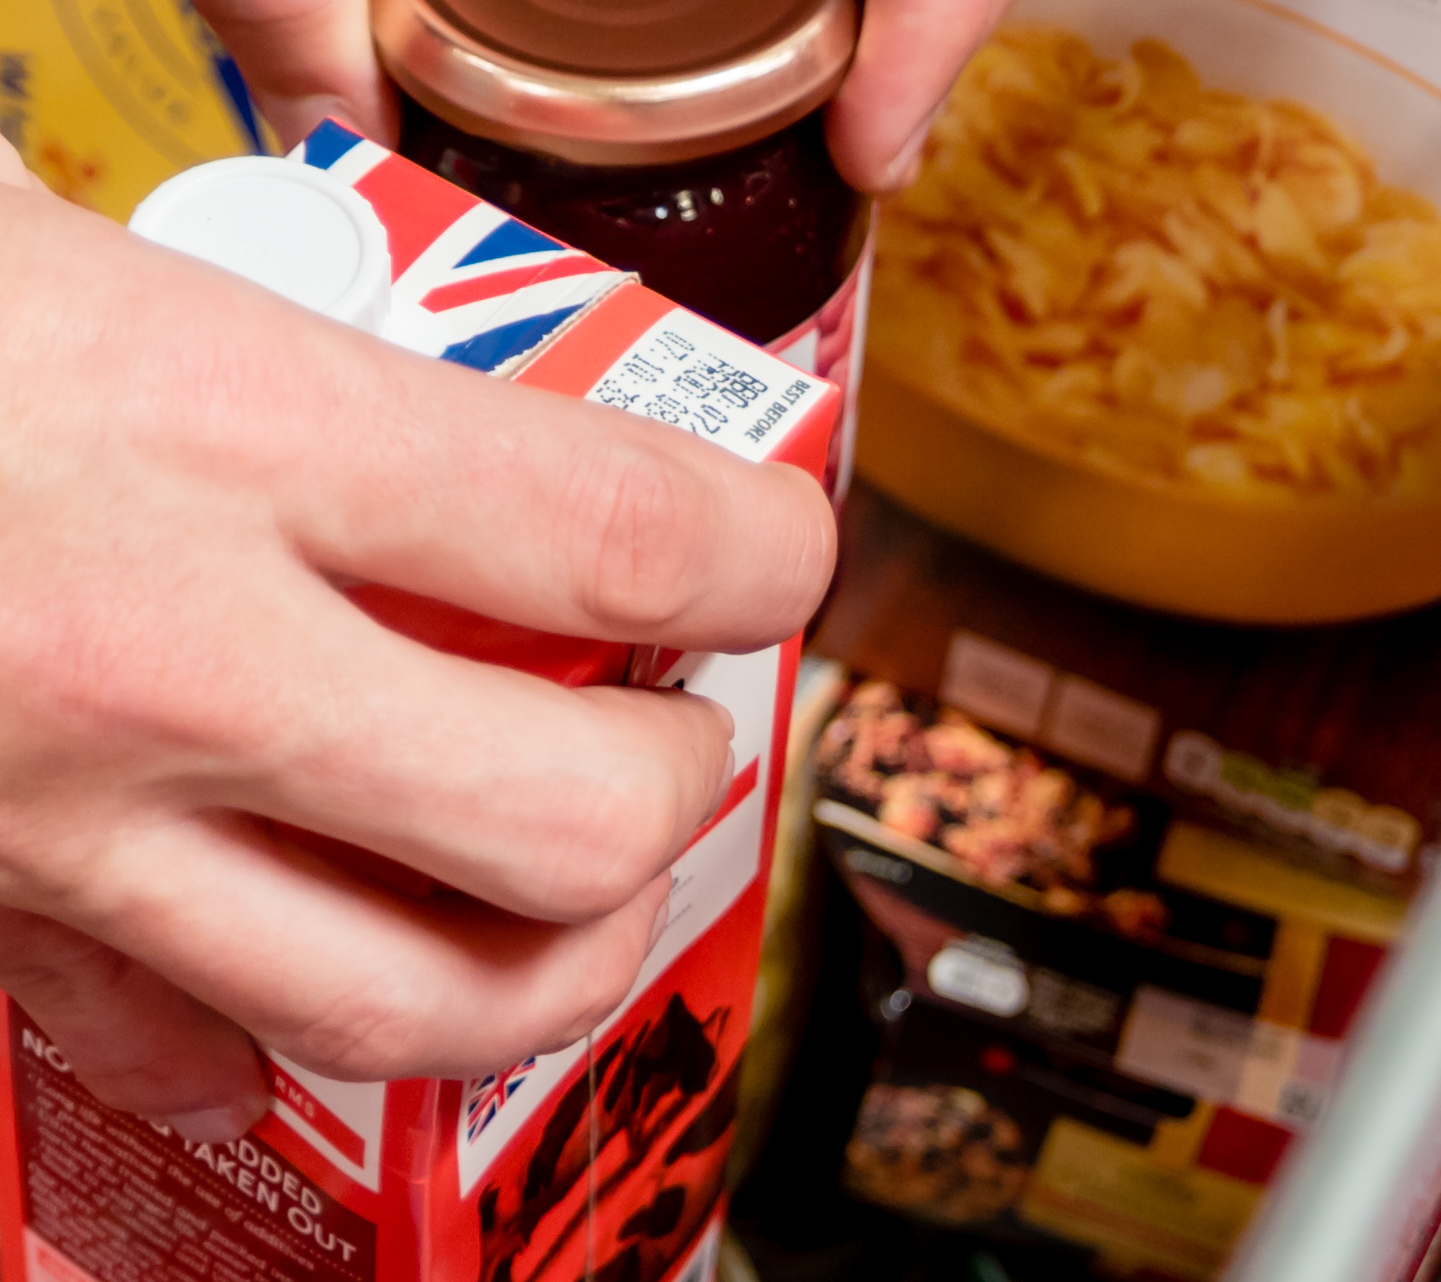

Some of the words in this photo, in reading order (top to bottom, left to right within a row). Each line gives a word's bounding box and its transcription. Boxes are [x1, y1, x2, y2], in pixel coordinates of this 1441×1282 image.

[786, 379, 811, 406] BEST
[744, 401, 788, 443] BEFORE
[273, 1074, 317, 1118] RMS
[183, 1138, 280, 1212] TAKEN
[287, 1207, 357, 1262] OUT
